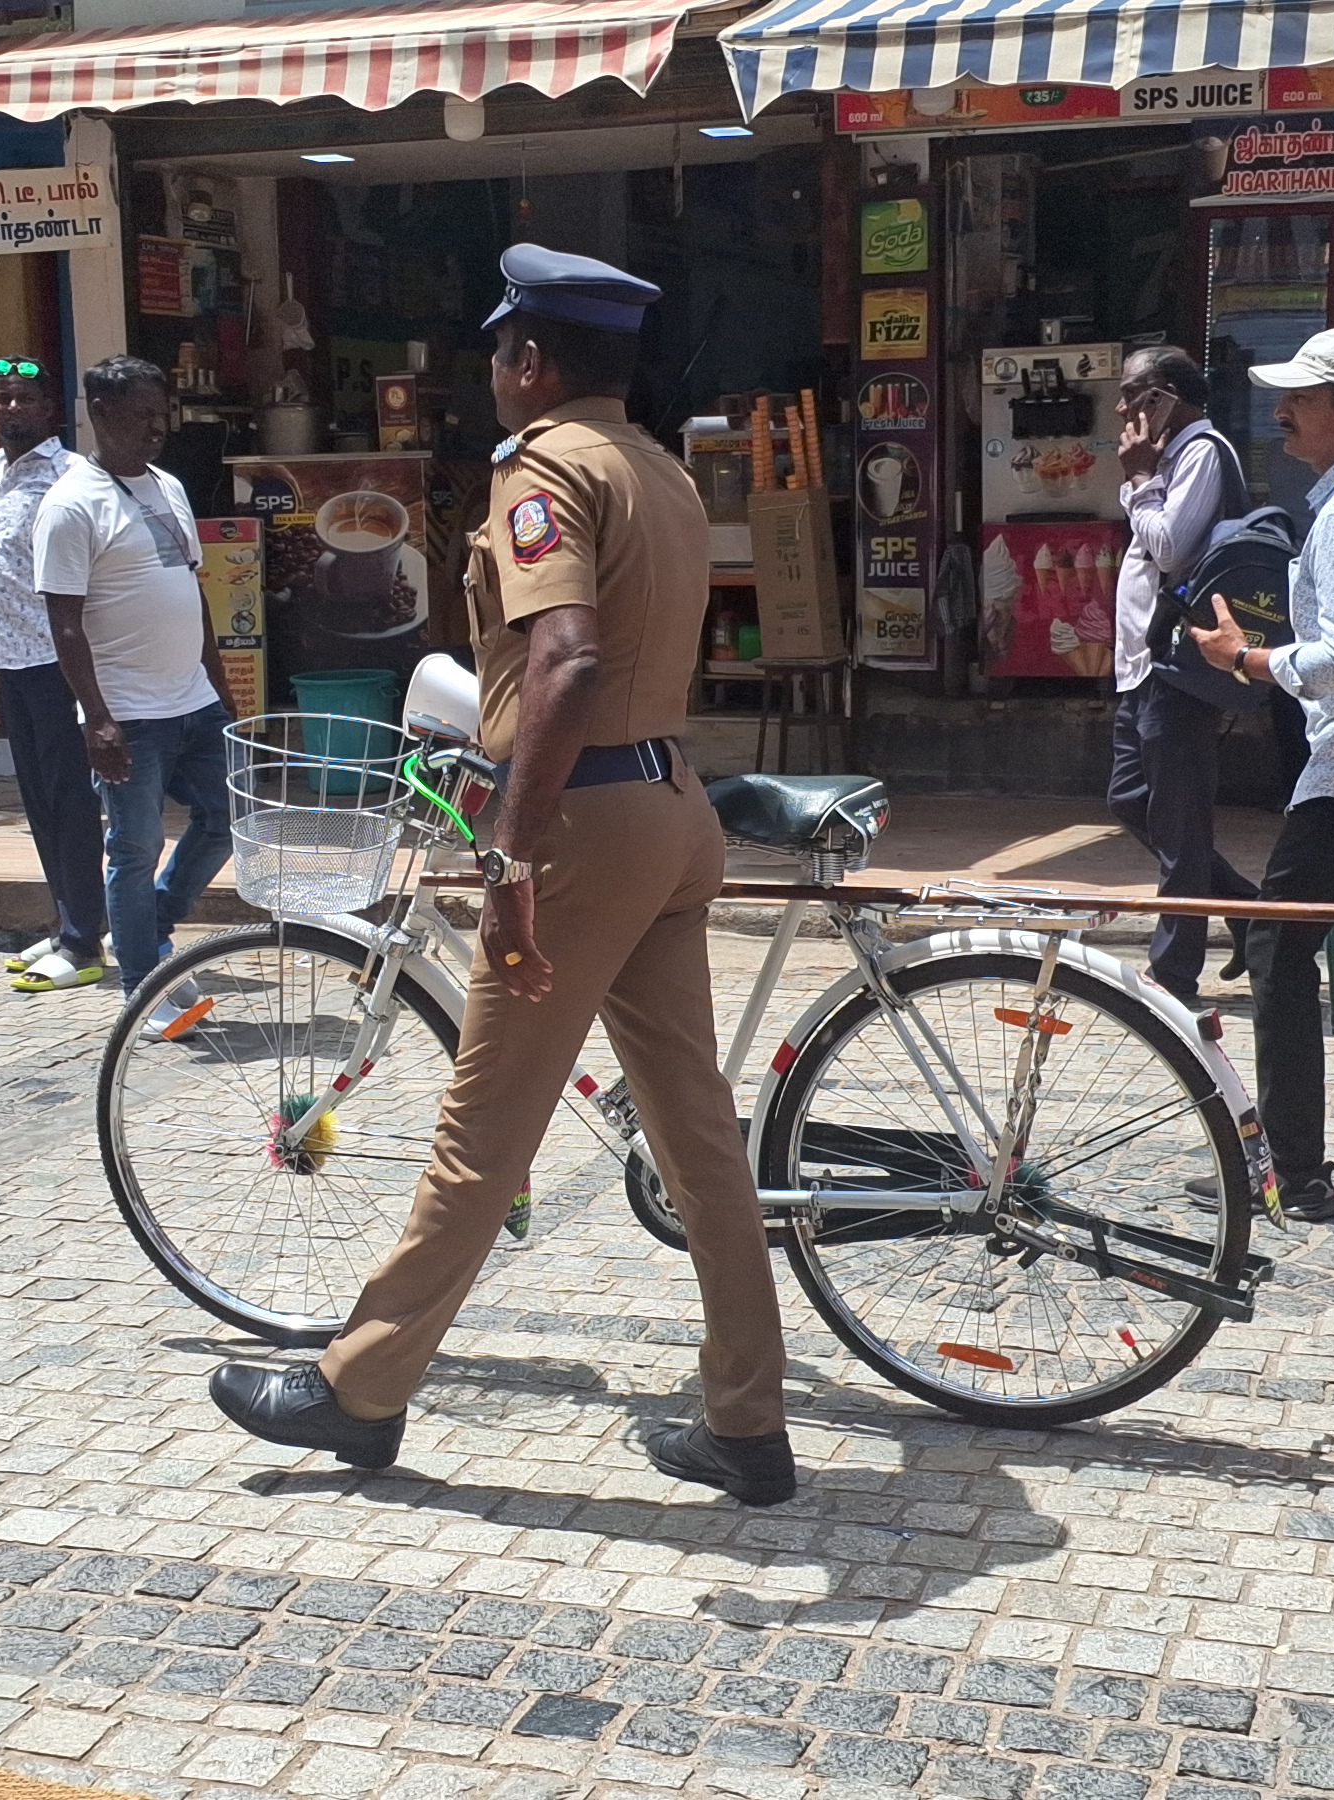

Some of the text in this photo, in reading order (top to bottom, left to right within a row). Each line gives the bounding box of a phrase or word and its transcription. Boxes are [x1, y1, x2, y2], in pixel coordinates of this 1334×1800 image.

[1133, 83, 1253, 110] SPS JUICE
[1282, 91, 1305, 102] 600
[848, 112, 883, 123] 600 ml
[47, 172, 99, 201] பால்
[866, 223, 923, 255] Soda
[255, 494, 295, 511] SPS
[870, 537, 917, 560] SPS
[868, 562, 920, 577] JUICE
[884, 610, 923, 624] Ginger
[876, 620, 923, 639] Beer
